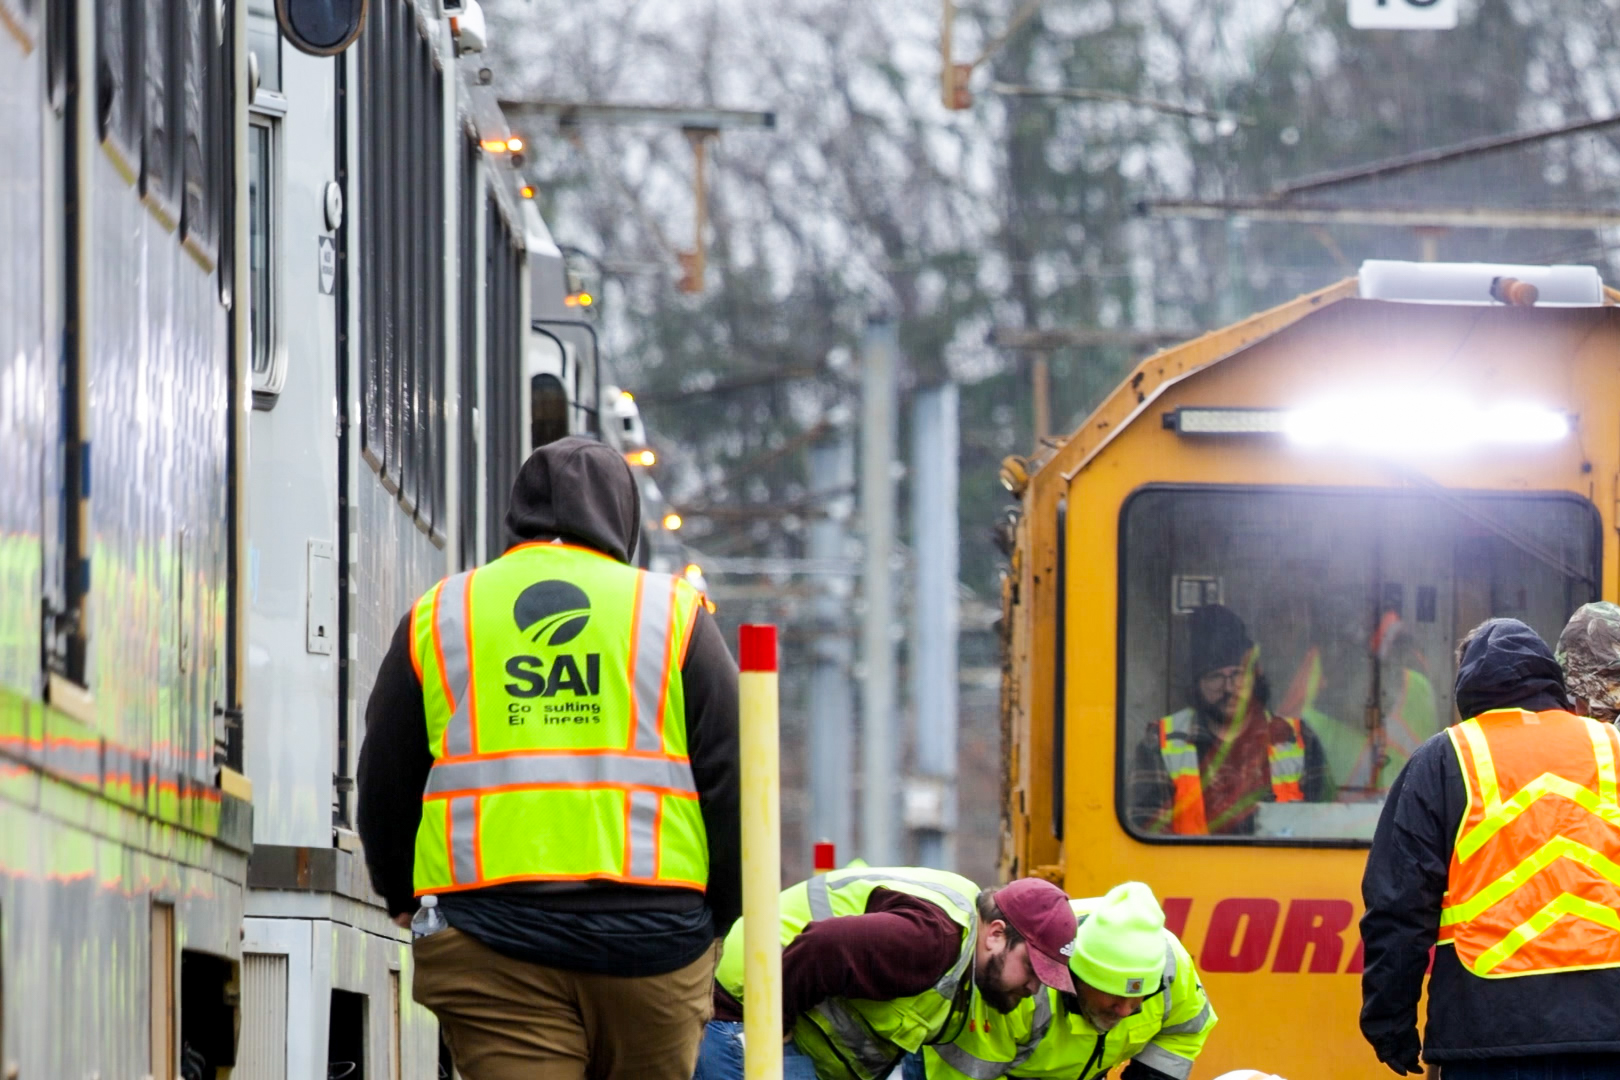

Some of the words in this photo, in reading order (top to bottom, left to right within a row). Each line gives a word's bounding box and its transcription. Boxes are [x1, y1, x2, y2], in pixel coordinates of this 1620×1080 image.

[504, 653, 600, 698] SAI
[508, 701, 600, 714] Cosulting
[508, 714, 600, 726] Eineers
